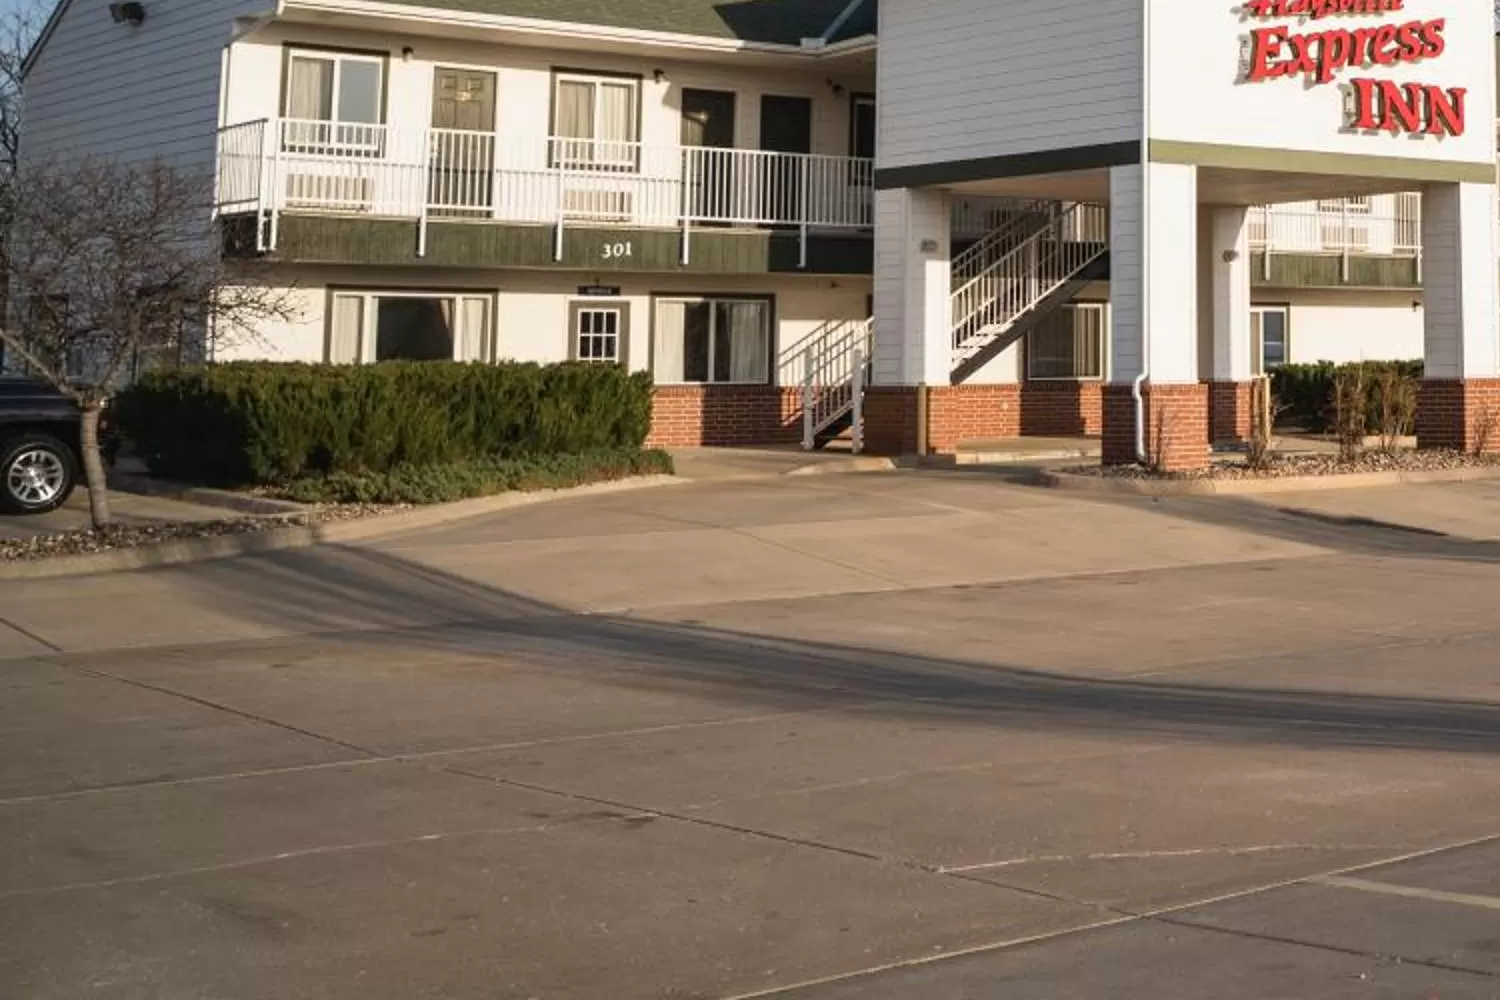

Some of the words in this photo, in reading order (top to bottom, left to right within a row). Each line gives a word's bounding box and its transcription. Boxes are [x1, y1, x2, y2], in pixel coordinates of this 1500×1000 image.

[1249, 17, 1446, 84] Express
[1350, 77, 1468, 137] INN
[601, 241, 633, 259] 301
